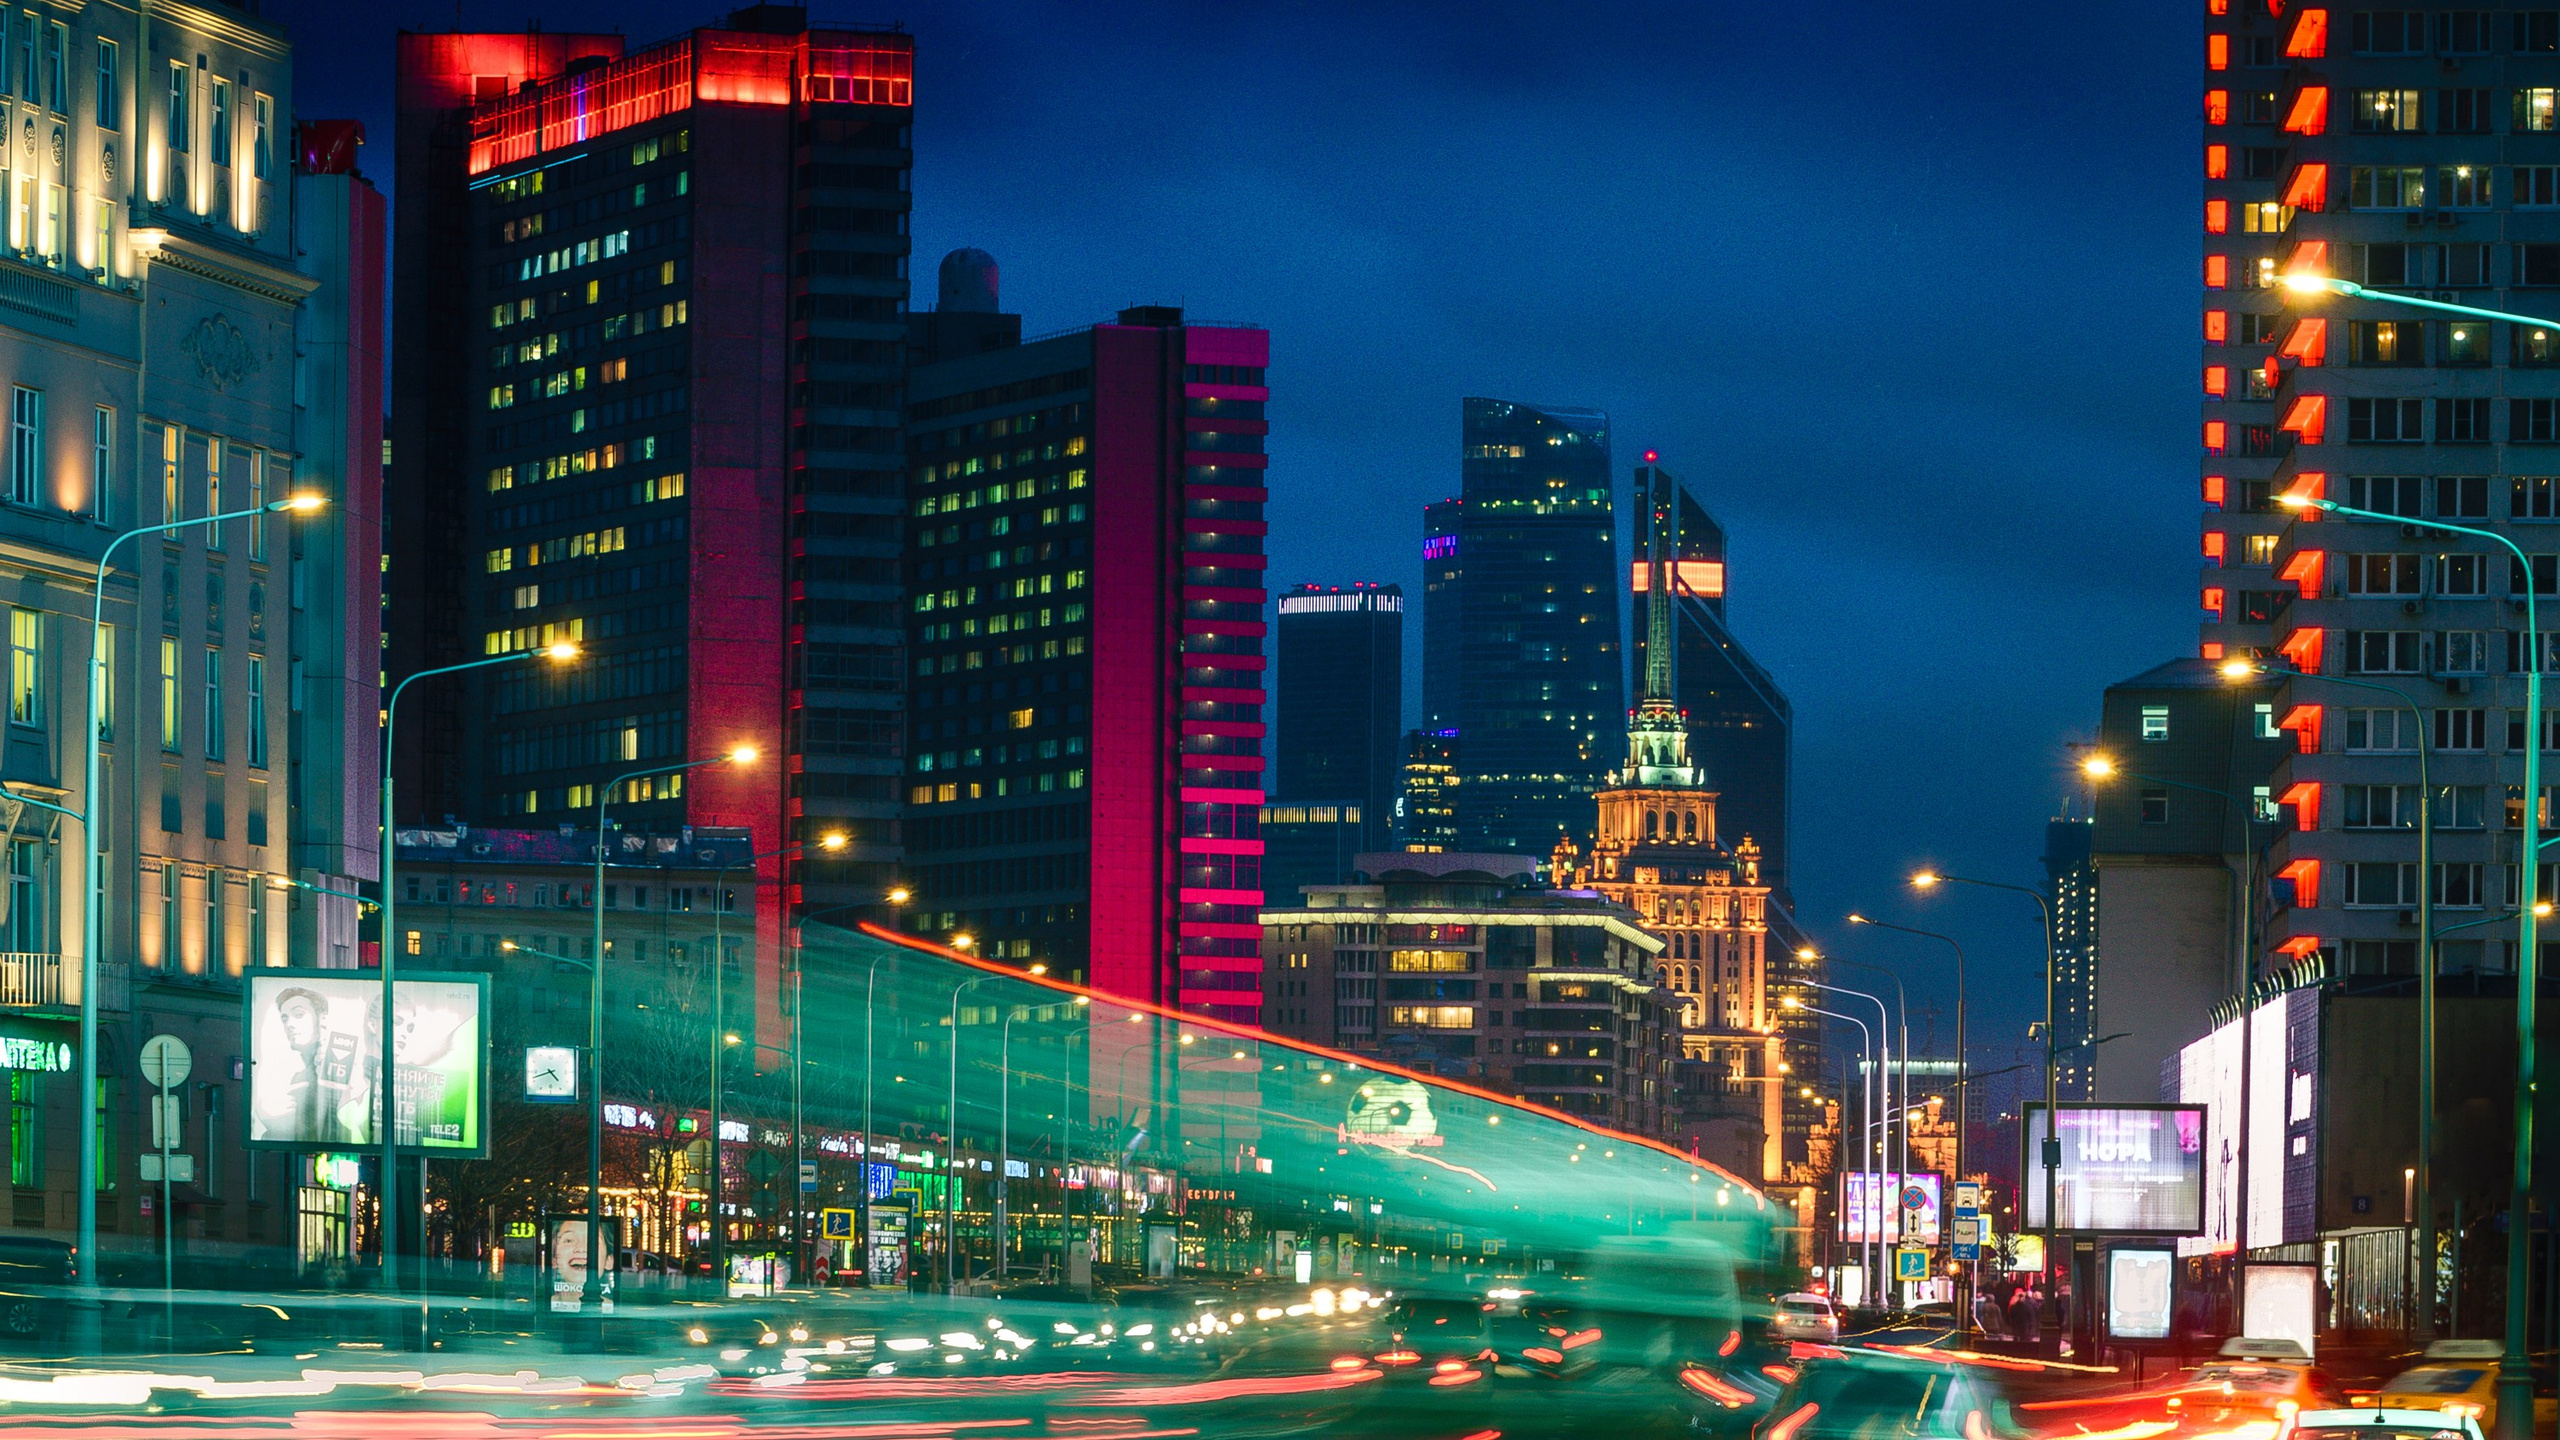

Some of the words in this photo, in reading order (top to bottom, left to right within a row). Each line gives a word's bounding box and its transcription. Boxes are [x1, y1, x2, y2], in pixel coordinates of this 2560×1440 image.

[327, 1062, 347, 1077] ГБ
[430, 1124, 460, 1136] TELE2
[2078, 1142, 2152, 1162] НОРА
[1187, 1189, 1236, 1201] ЕСТОРАН
[2358, 1198, 2366, 1210] 8
